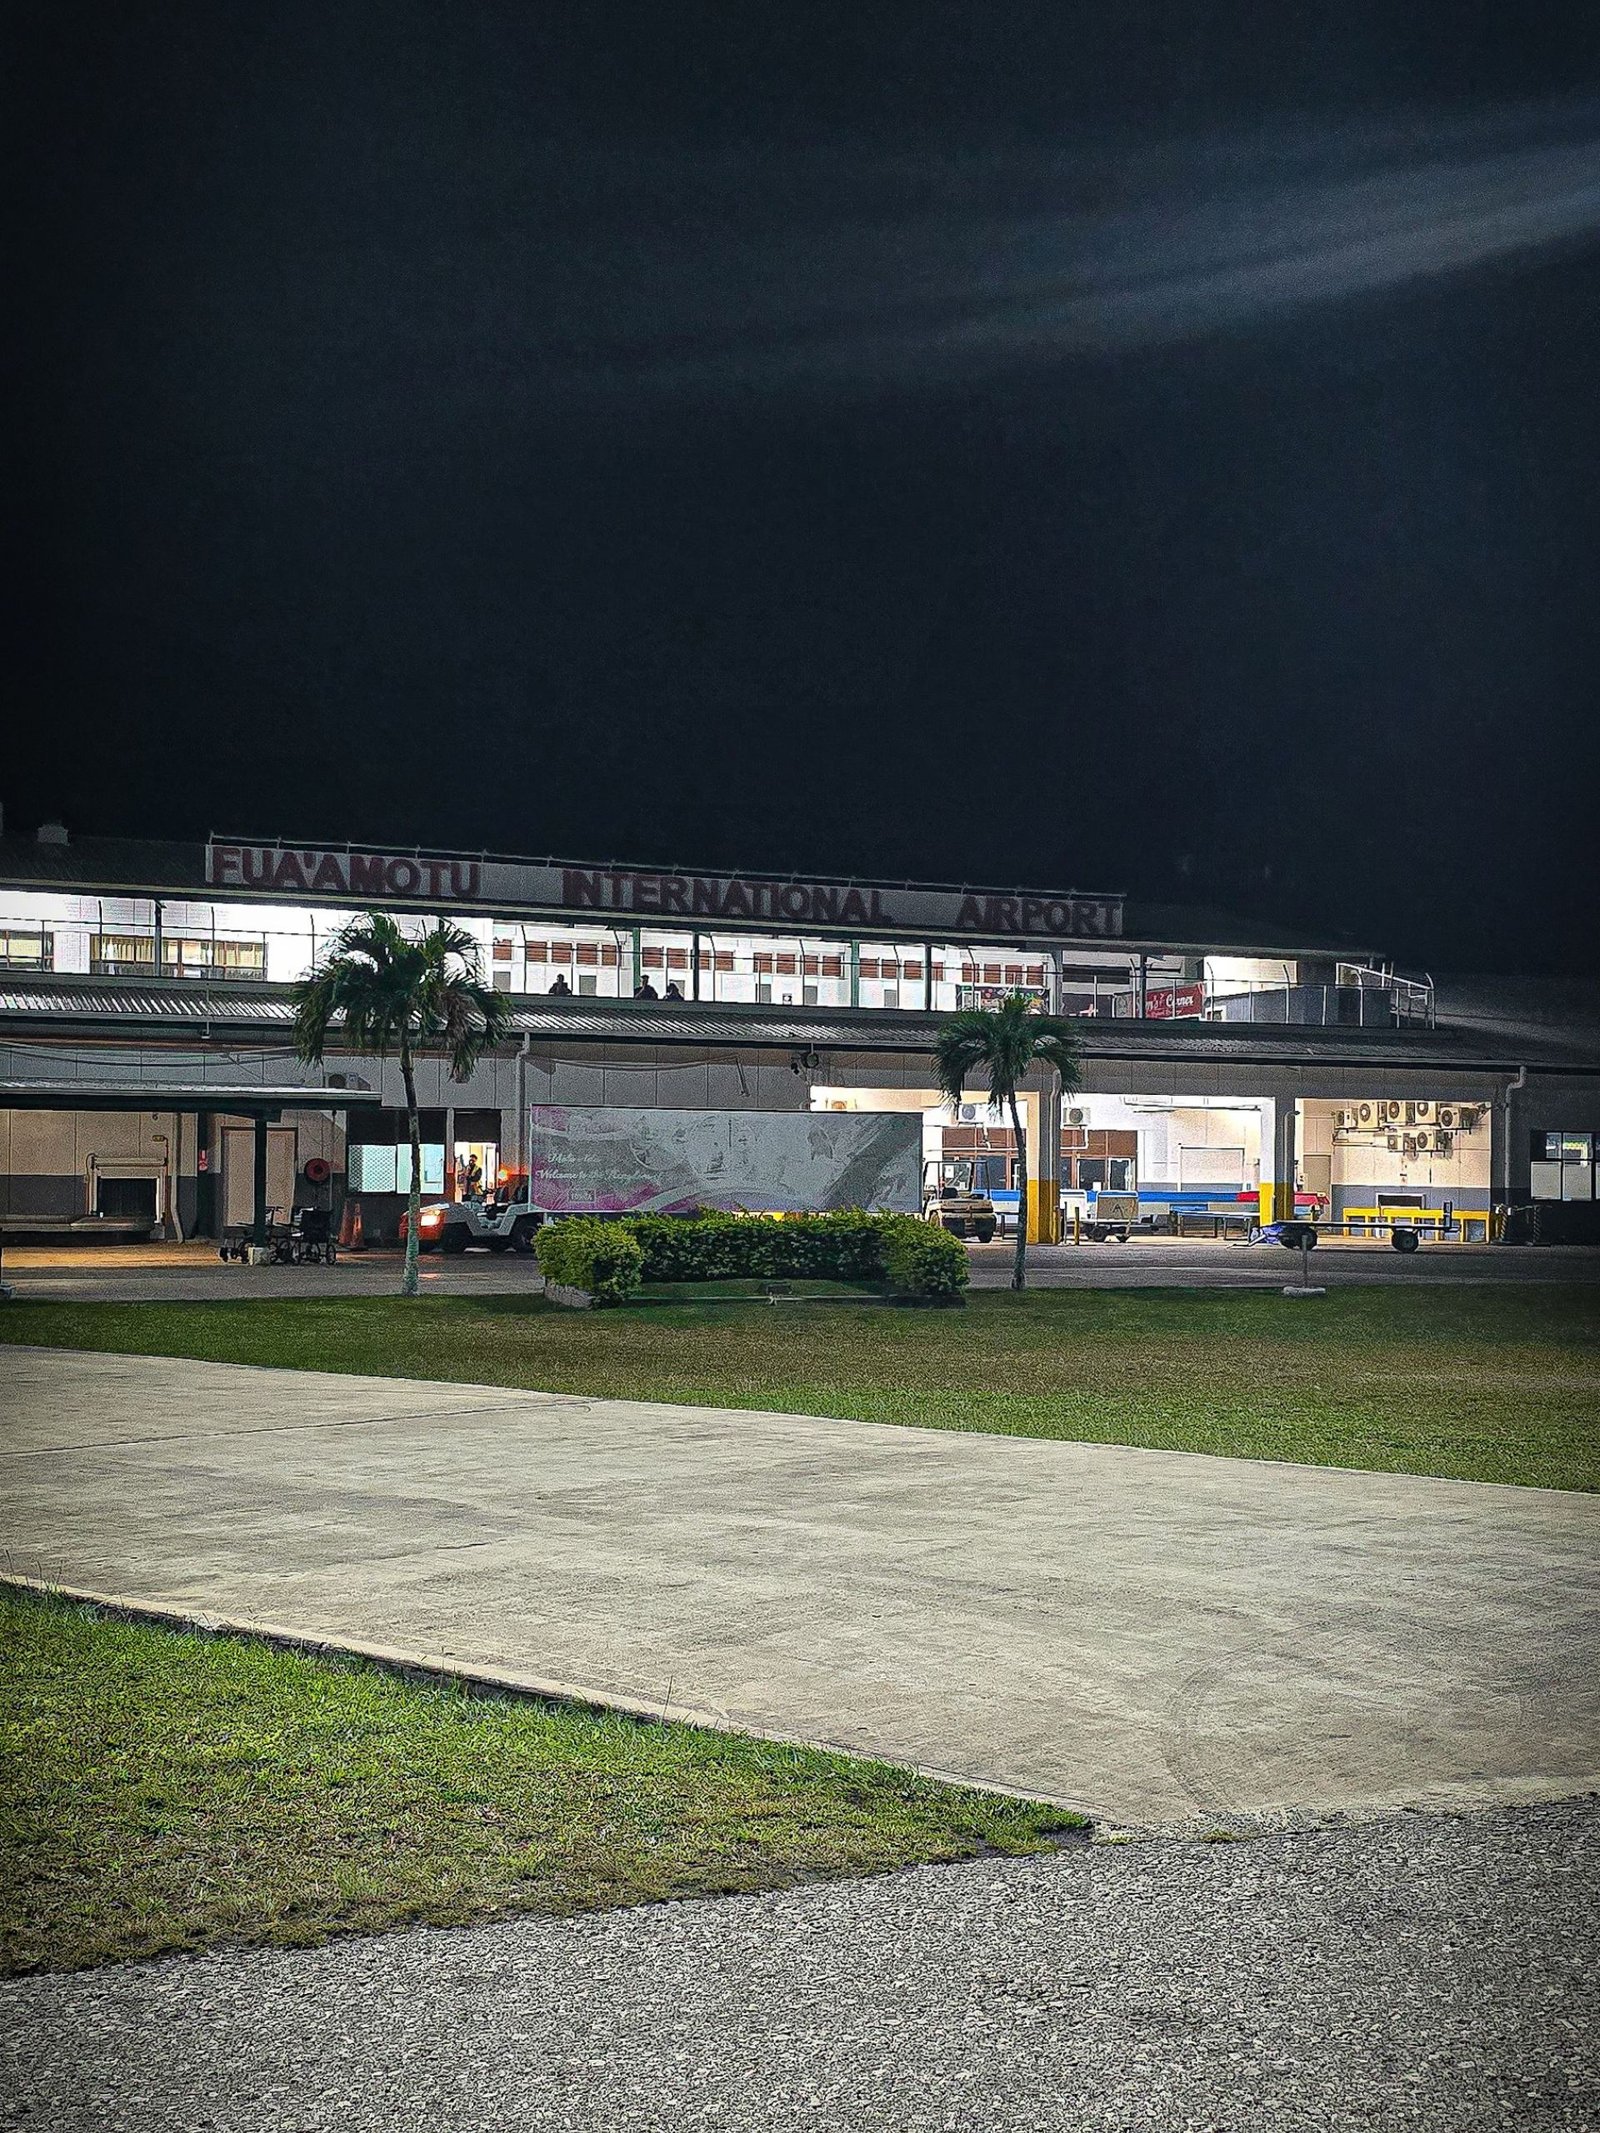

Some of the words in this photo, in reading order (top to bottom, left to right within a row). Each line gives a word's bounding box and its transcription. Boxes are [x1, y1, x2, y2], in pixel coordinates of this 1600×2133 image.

[212, 846, 479, 897] FUA'AMOTU
[562, 869, 892, 922] INTERNATIONAL
[955, 895, 1123, 936] AIRPORT
